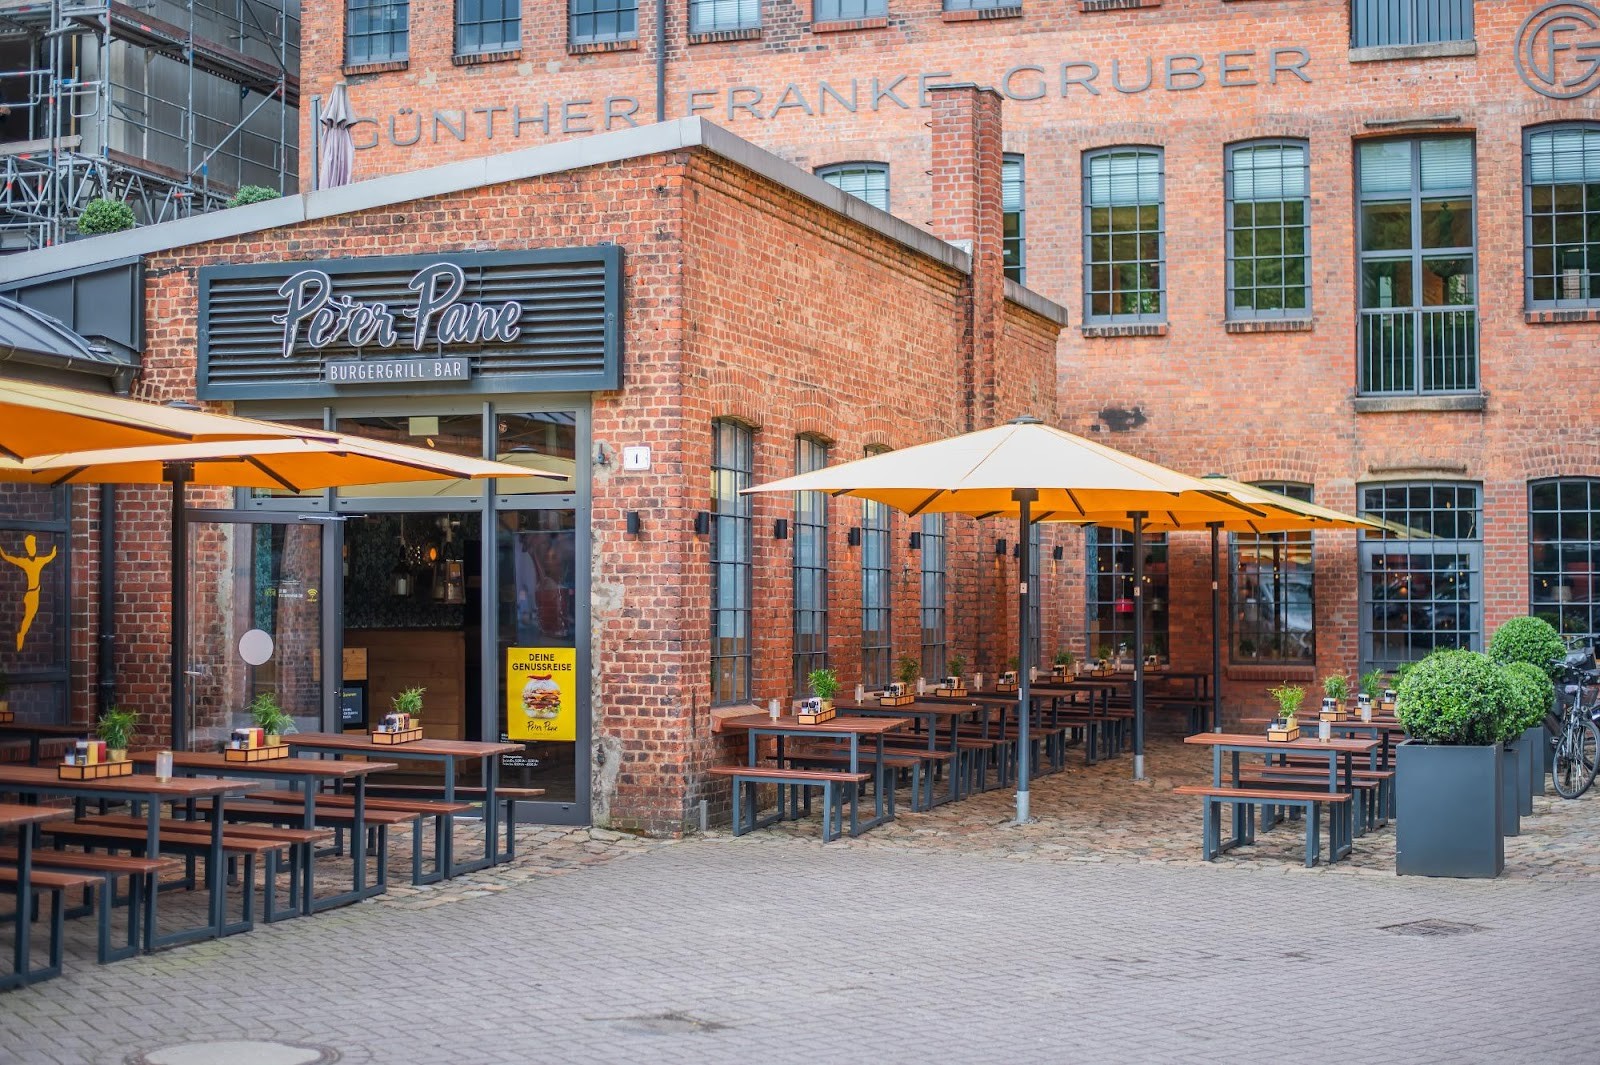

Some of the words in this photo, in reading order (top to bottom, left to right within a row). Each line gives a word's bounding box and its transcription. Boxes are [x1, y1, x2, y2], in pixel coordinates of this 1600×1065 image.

[351, 95, 641, 150] GÜNTHER
[687, 71, 952, 121] FRANKE
[1001, 46, 1312, 101] GRUBER
[272, 269, 397, 358] Peter
[402, 262, 522, 351] Pane
[330, 363, 425, 381] BURGERGRILL
[434, 362, 462, 376] BAR
[512, 663, 571, 671] GENUSSREISE
[529, 653, 554, 662] DEINE
